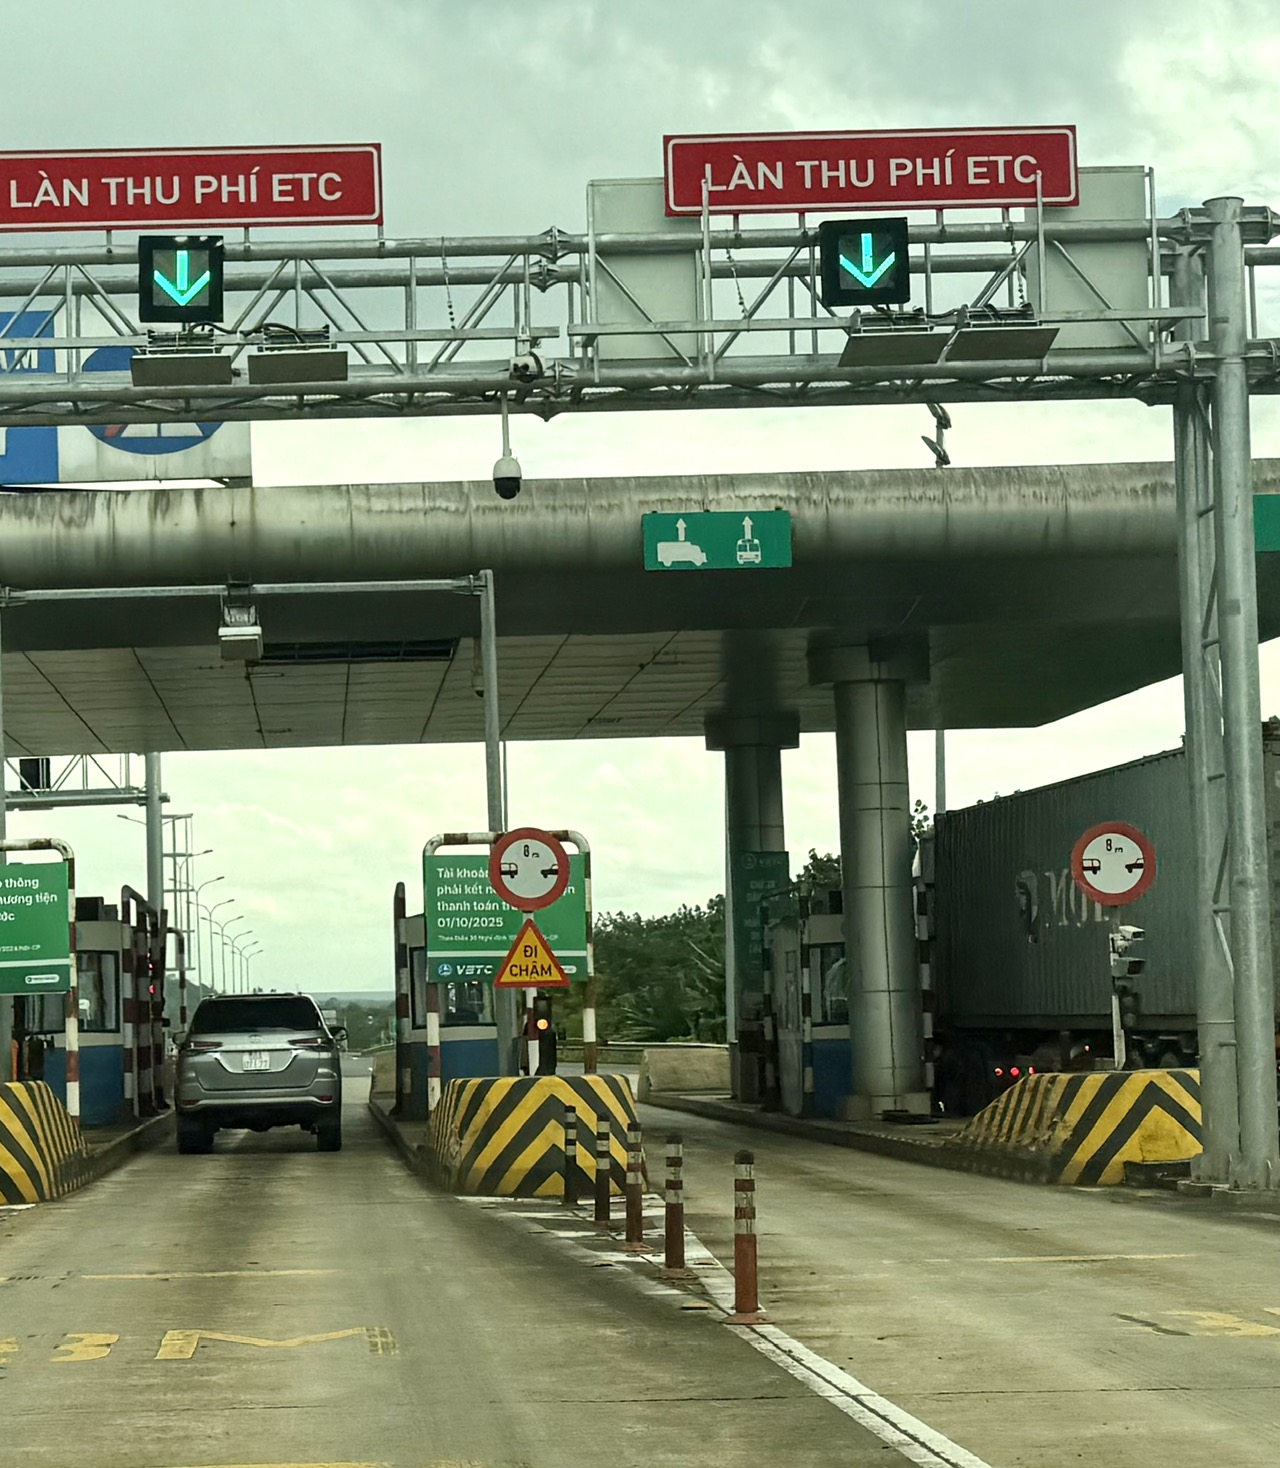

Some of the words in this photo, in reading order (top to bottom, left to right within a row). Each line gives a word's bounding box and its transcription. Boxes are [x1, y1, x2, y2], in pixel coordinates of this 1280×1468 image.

[704, 154, 783, 192] LÀN
[795, 159, 875, 188] THU
[889, 149, 955, 186] PHÍ
[967, 155, 1038, 184] ETC
[10, 170, 90, 208] LÀN
[101, 175, 181, 206] THU
[194, 166, 261, 204] PHÍ
[272, 172, 343, 202] ETC
[1105, 838, 1113, 852] 8
[436, 867, 454, 879] Tài
[5, 876, 39, 889] thông
[436, 884, 462, 897] phải
[464, 882, 483, 895] kết
[35, 891, 58, 906] tiện
[437, 901, 471, 911] thanh
[473, 900, 499, 911] toán
[437, 917, 504, 929] 01/10/2025
[523, 945, 538, 958] ĐI
